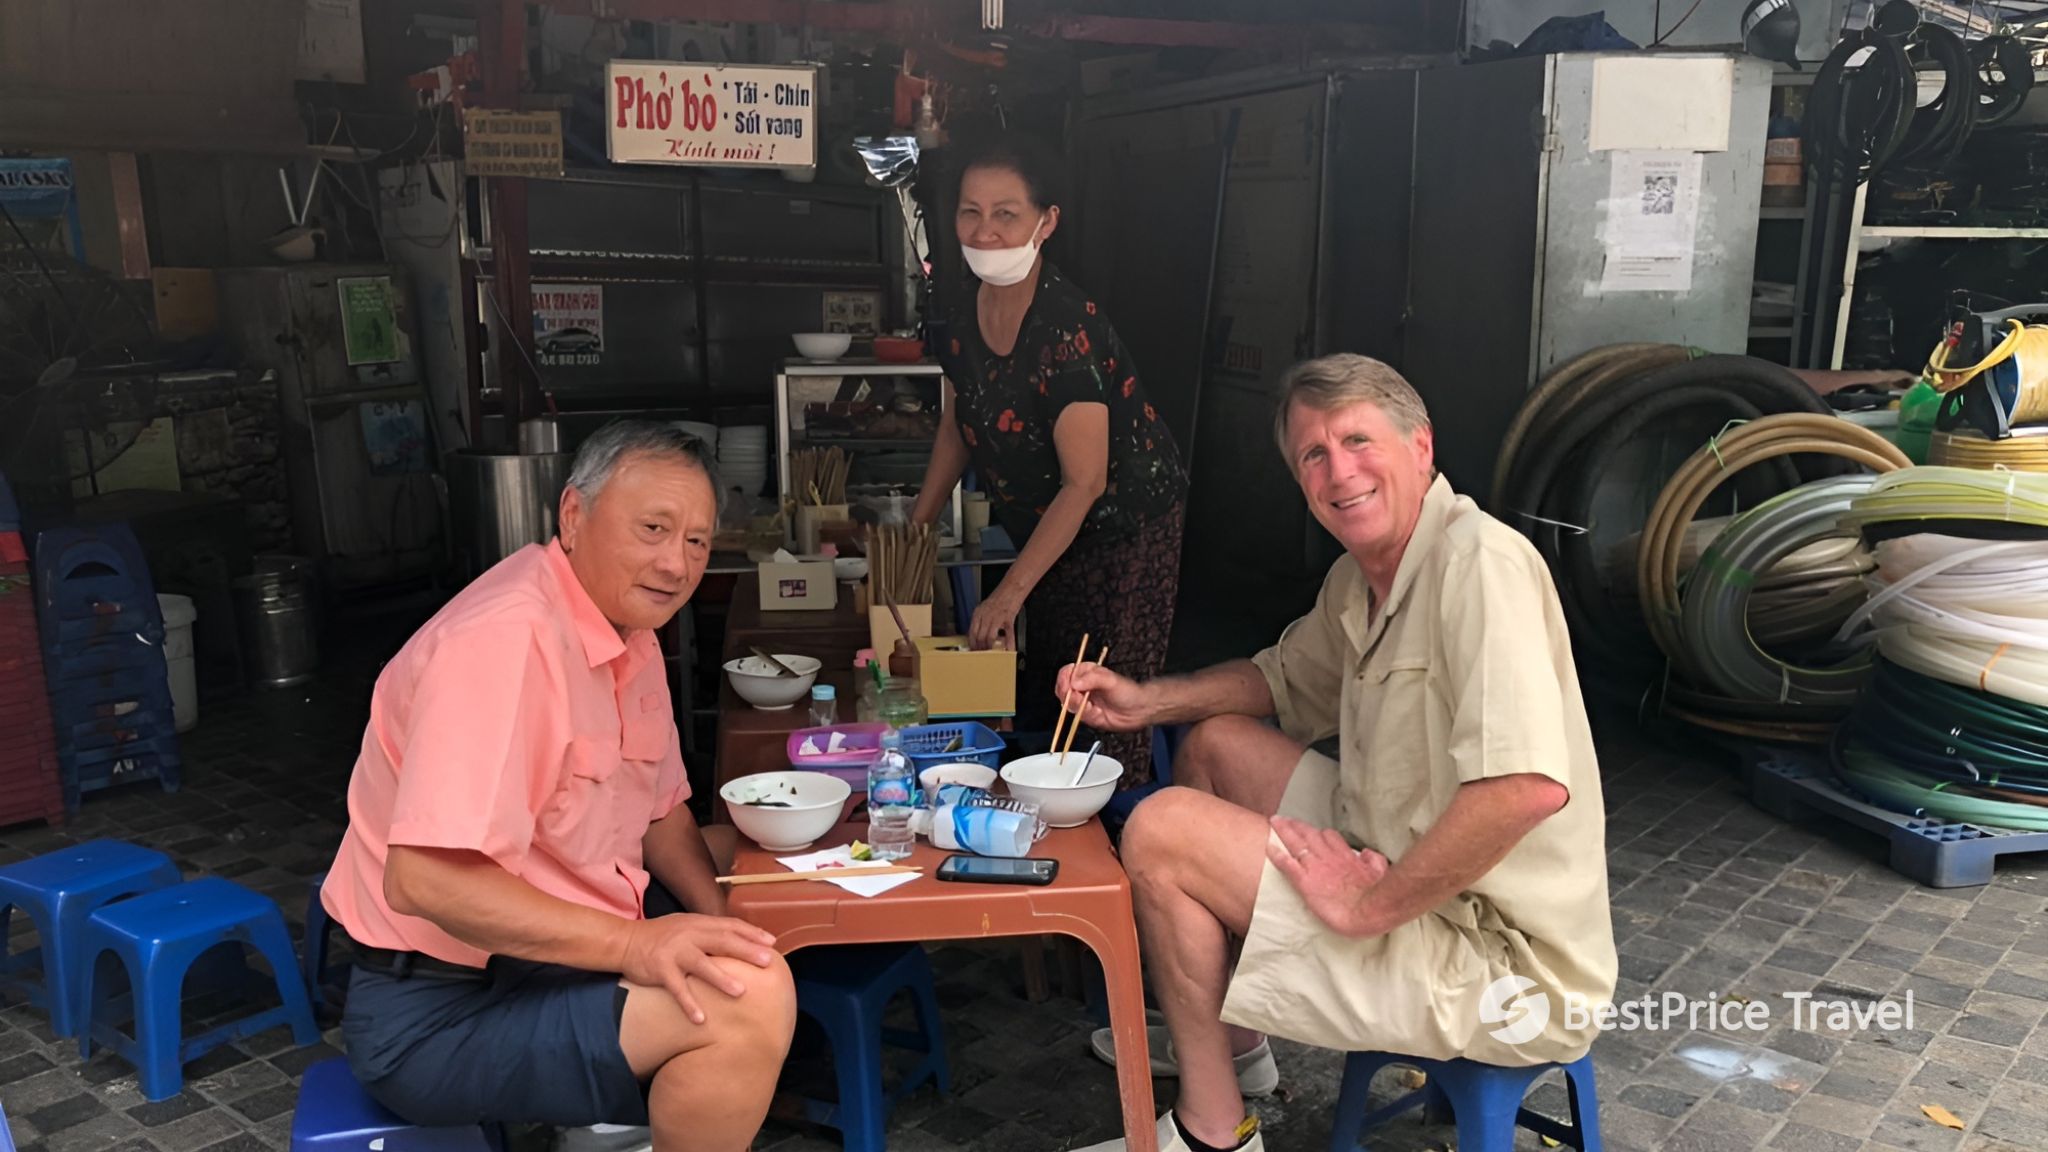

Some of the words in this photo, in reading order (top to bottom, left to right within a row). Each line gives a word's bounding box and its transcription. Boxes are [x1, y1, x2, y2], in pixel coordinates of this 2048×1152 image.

[615, 71, 673, 130] Phở
[681, 73, 717, 131] bò
[734, 81, 758, 104] Tái
[665, 139, 716, 158] Kính
